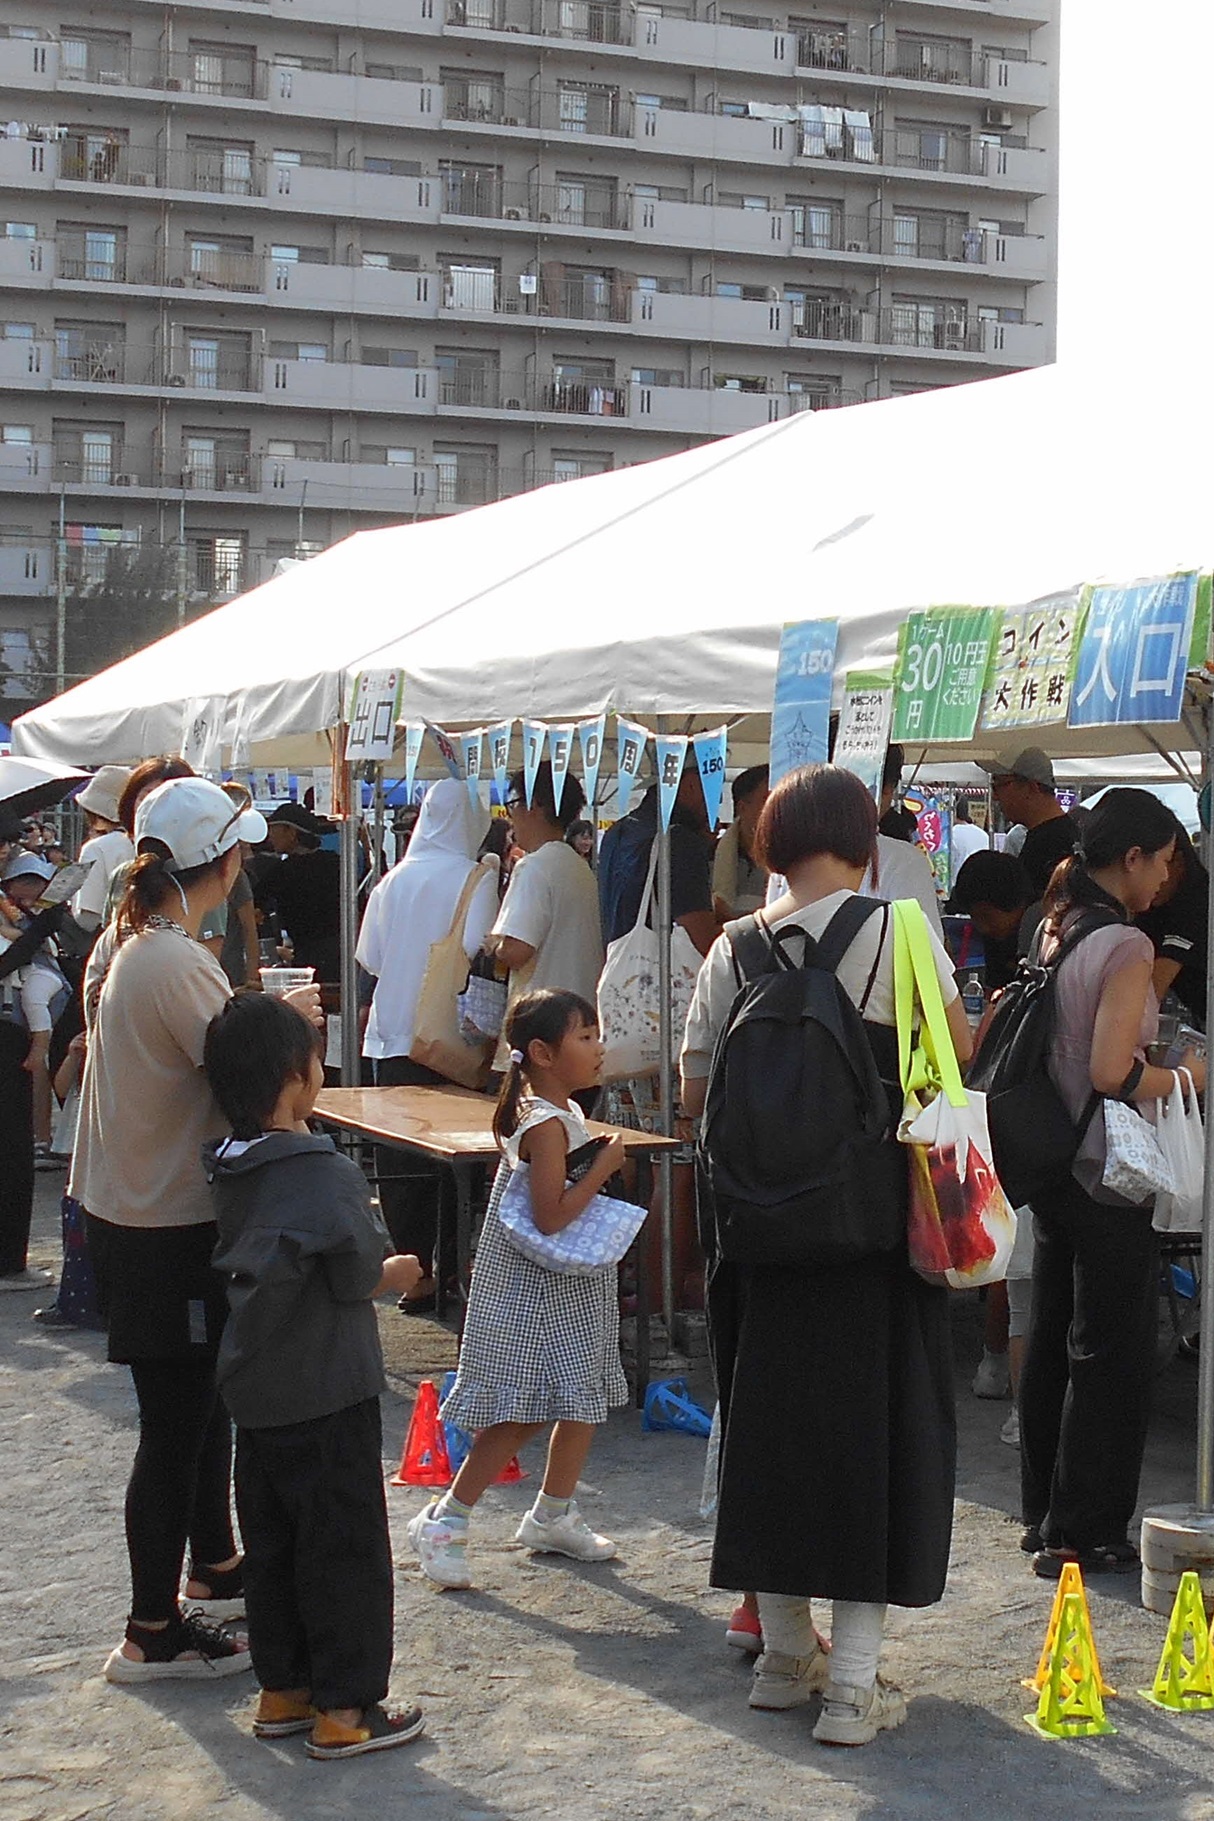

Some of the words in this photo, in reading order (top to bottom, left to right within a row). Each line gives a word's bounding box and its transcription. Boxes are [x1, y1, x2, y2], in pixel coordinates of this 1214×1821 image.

[913, 622, 944, 641] 1ゲーム
[1002, 618, 1071, 657] コイン
[797, 648, 833, 677] 150
[901, 642, 942, 693] 30
[946, 641, 988, 666] 10円玉
[1076, 623, 1182, 707] 入口
[949, 668, 977, 687] ご用意
[993, 673, 1066, 712] 大作戦
[942, 687, 976, 706] ください
[350, 697, 394, 749] 出口
[905, 699, 923, 730] 円
[702, 756, 724, 775] 150
